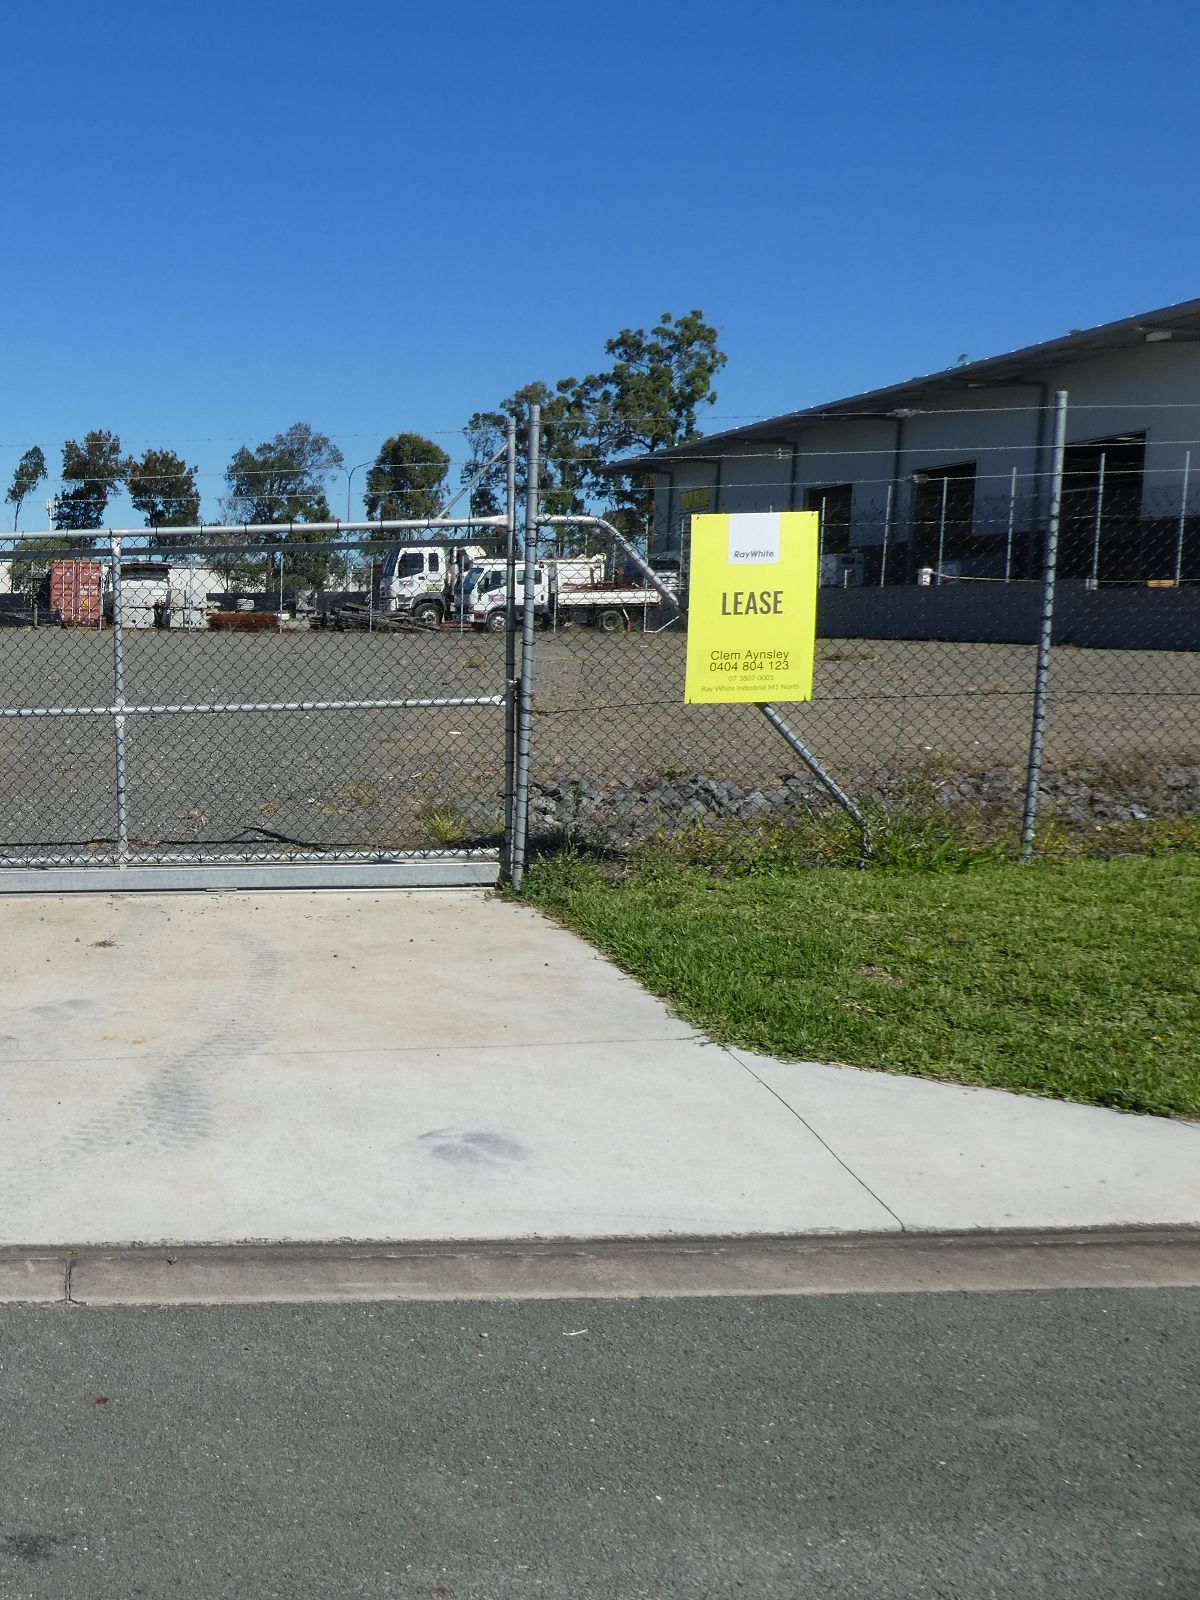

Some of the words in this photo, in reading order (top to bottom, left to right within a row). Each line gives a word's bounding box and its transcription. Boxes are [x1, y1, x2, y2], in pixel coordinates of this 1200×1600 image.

[722, 591, 783, 615] LEASE
[710, 651, 740, 660] Clem
[745, 649, 789, 661] Aynsley
[709, 662, 738, 671] 0404
[742, 661, 763, 671] 804
[769, 660, 789, 670] 123
